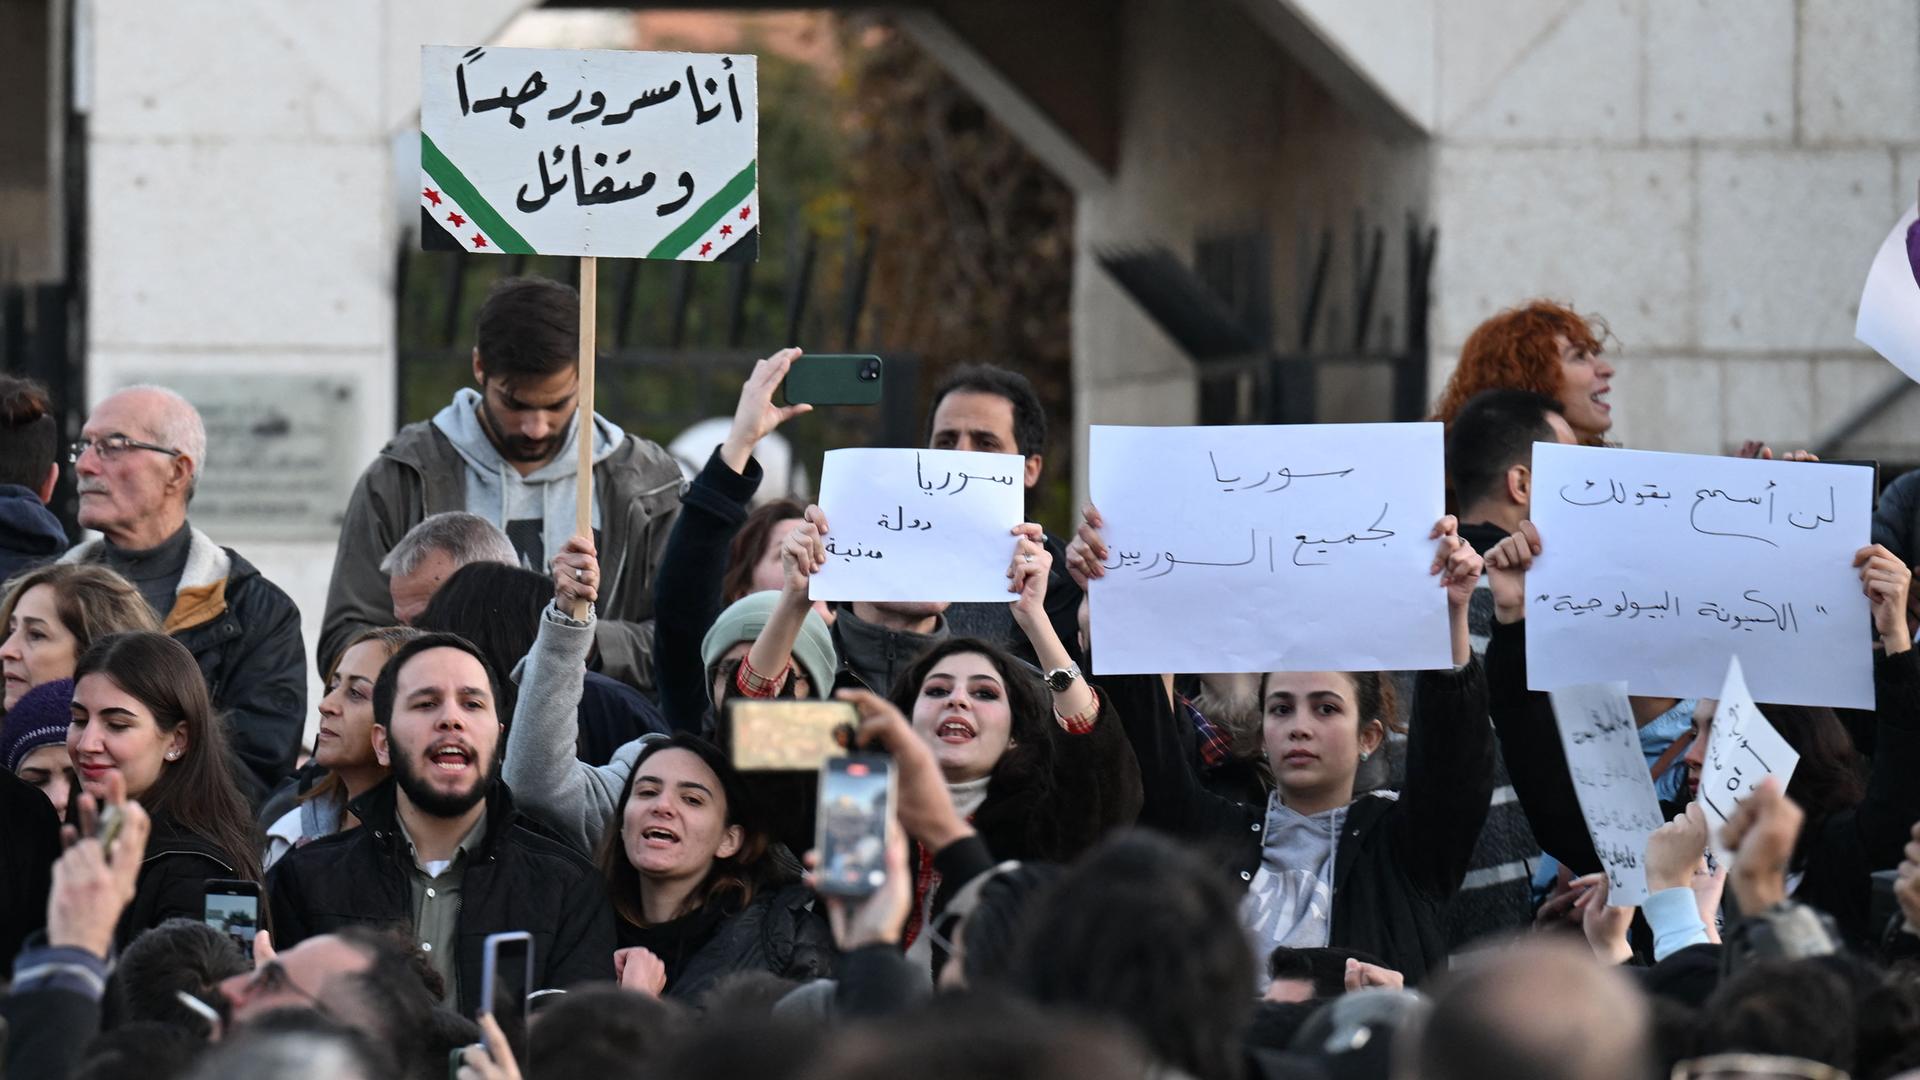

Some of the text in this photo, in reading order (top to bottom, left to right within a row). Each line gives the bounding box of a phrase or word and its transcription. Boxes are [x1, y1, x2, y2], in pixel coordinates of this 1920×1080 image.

[548, 80, 682, 126] مسرور
[686, 57, 743, 125] أنا
[917, 451, 1013, 496] سوريا
[1210, 451, 1354, 493] سوريا
[1560, 478, 1671, 507] بقولك
[878, 506, 932, 531] دولة
[1788, 486, 1834, 529] لن
[825, 538, 883, 562] مدنية
[1103, 503, 1395, 580] لجميع السوريين
